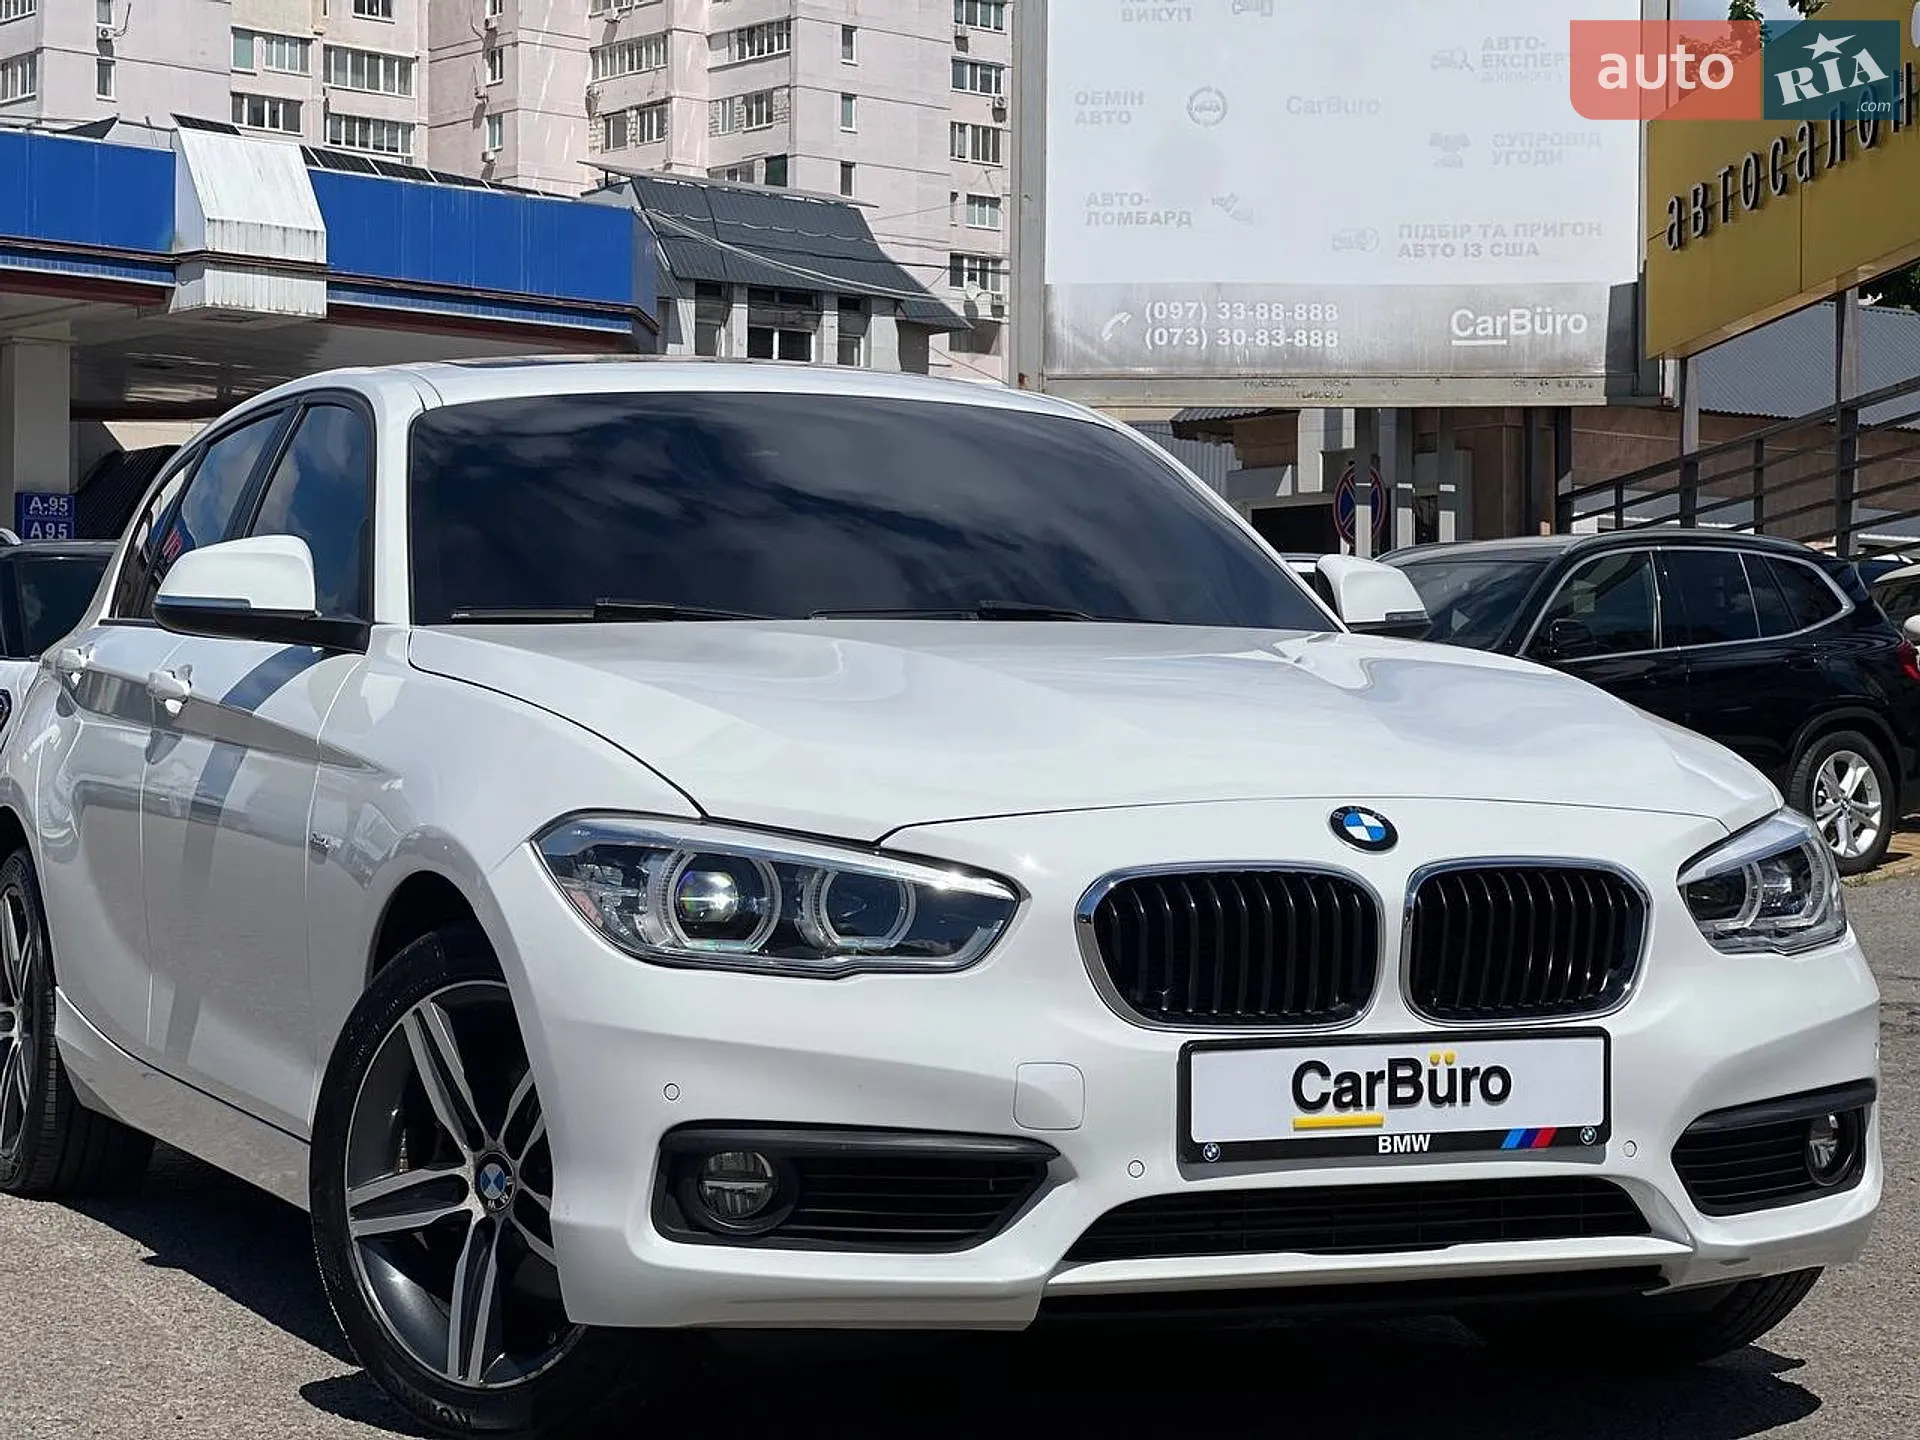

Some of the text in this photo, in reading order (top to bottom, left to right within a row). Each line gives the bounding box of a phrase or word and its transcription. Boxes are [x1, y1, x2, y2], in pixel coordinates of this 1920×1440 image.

[1121, 7, 1192, 23] ВИКУП
[1481, 36, 1546, 51] АВТО-
[1074, 90, 1144, 106] ОБМІН
[1074, 110, 1132, 125] АВТО
[1492, 132, 1602, 149] СУПРОВІД
[1491, 149, 1563, 166] УГОДИ
[1666, 61, 1913, 250] автосалон
[1085, 192, 1150, 207] АВТО-
[1085, 210, 1192, 227] ЛОМБАРД
[1398, 222, 1601, 240] ПІДБІР ТА ПРИГОН
[1397, 243, 1456, 258] АВТО
[1489, 241, 1539, 257] США
[1145, 302, 1339, 323] (097) 33-88-888
[1451, 307, 1588, 338] CarBüro
[1145, 328, 1339, 350] (073) 30-83-888
[1291, 1051, 1512, 1111] CarBüro
[1378, 1134, 1431, 1154] BMW
